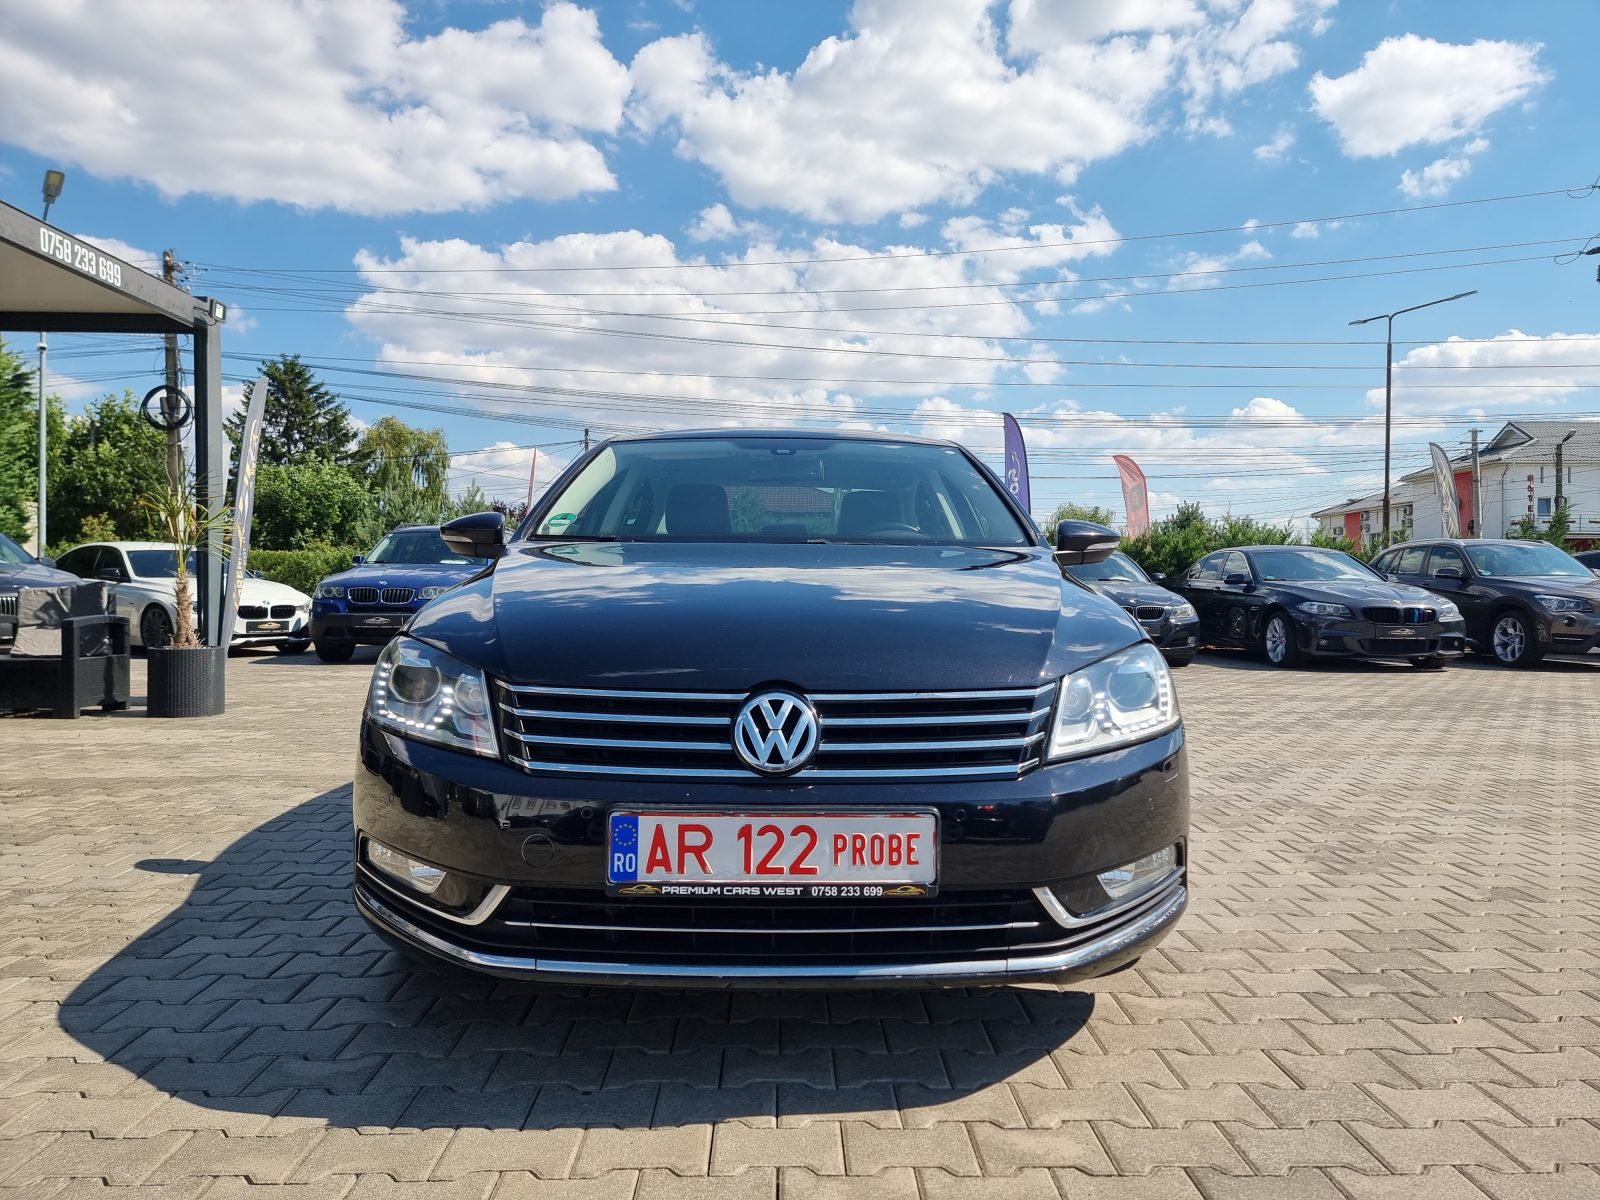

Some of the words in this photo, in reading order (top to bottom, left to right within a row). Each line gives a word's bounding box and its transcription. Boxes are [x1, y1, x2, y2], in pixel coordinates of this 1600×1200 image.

[40, 227, 72, 264] 0758
[74, 244, 97, 276] 233
[99, 256, 122, 287] 699
[613, 852, 636, 873] RO
[645, 823, 714, 875] AR
[737, 823, 819, 876] 122
[833, 832, 921, 867] PROBE
[661, 886, 721, 895] PREMIUM
[723, 886, 760, 896] CARS
[763, 887, 804, 896] WEST
[811, 886, 838, 897] 0758
[840, 886, 861, 897] 233
[863, 886, 883, 897] 699
